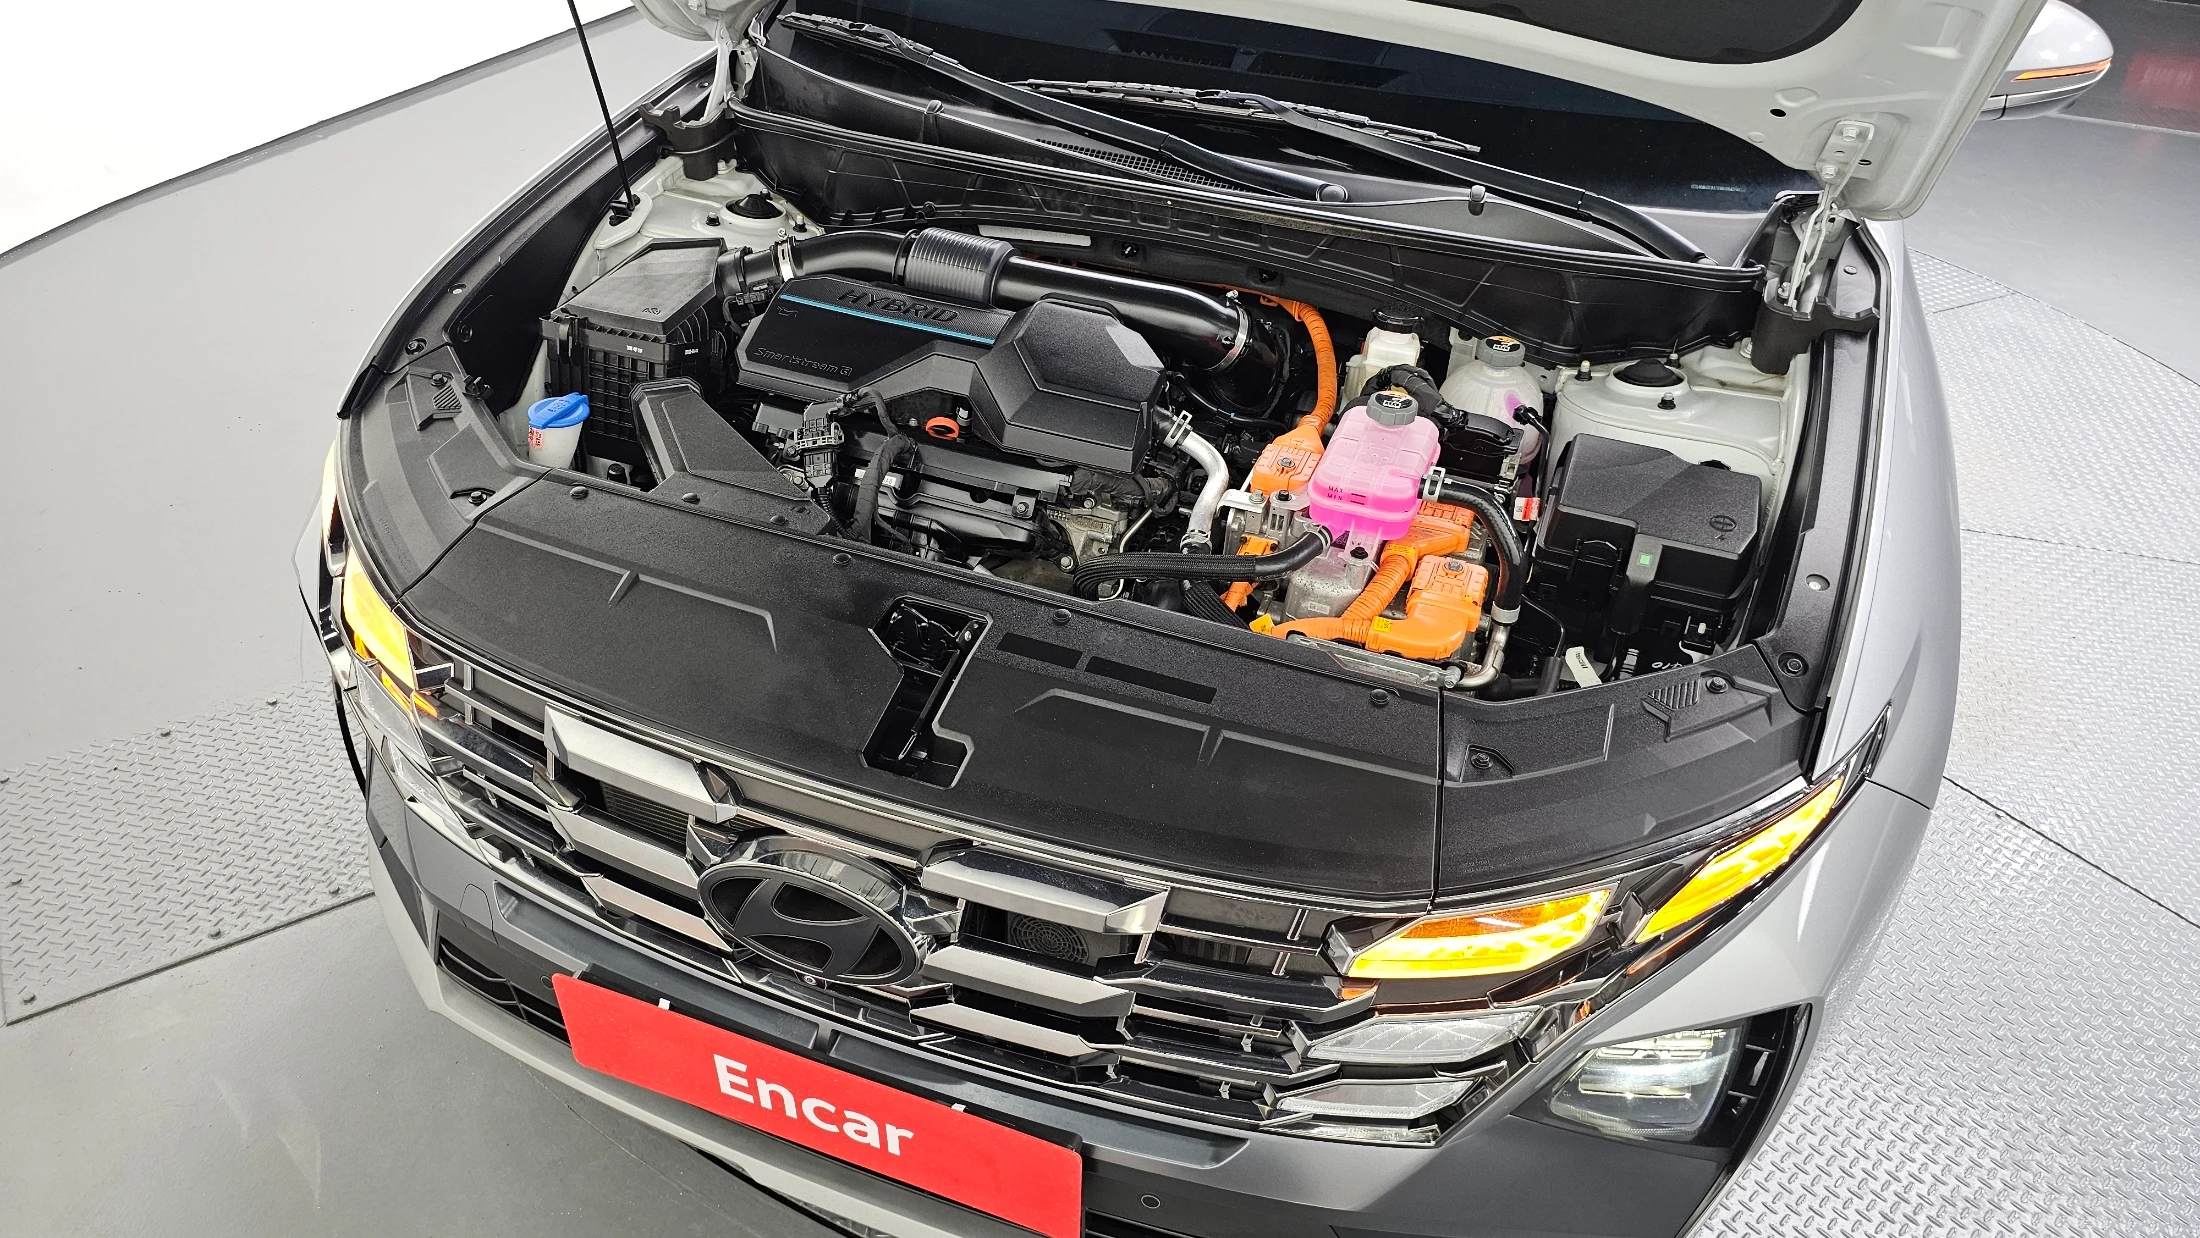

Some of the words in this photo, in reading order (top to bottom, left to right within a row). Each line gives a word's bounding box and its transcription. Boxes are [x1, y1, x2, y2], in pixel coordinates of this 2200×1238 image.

[837, 290, 959, 322] HYBRID
[754, 347, 838, 373] Smartstream
[1327, 493, 1342, 501] MIN
[1328, 485, 1343, 493] MAX
[713, 1053, 914, 1156] Encar
